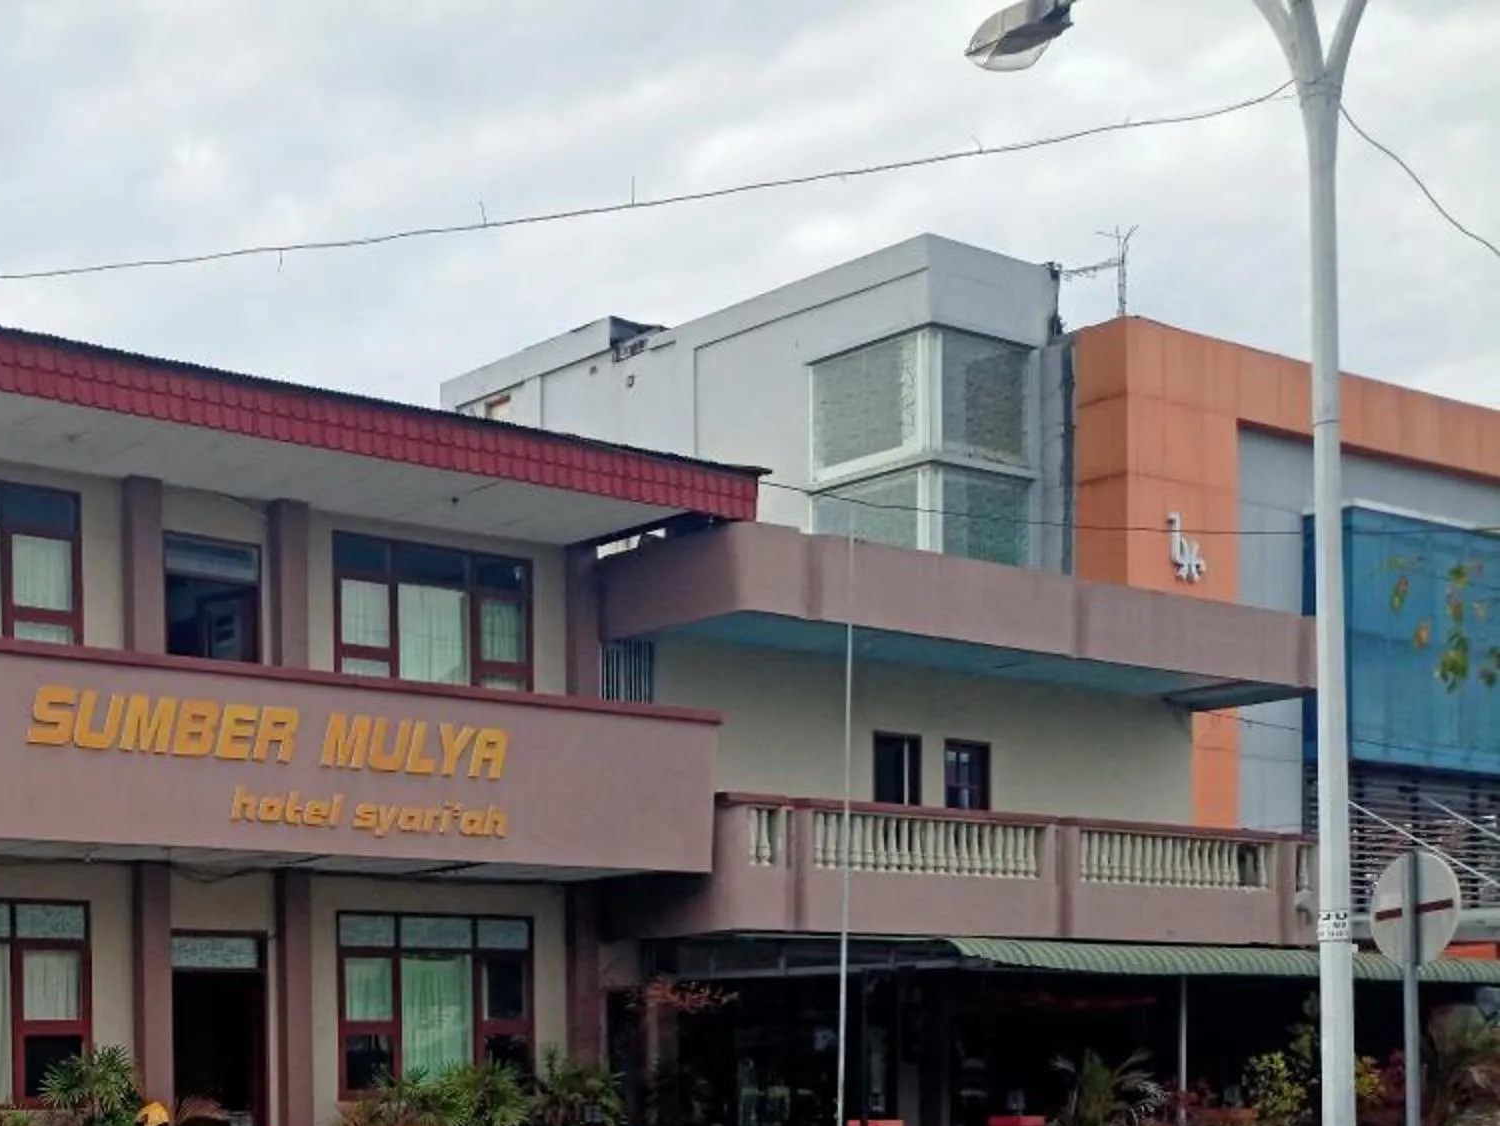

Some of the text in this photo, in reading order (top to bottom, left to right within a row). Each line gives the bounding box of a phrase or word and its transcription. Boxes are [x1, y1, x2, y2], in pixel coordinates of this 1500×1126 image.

[26, 686, 509, 780] SUMBER MULYA
[230, 786, 345, 828] hotel
